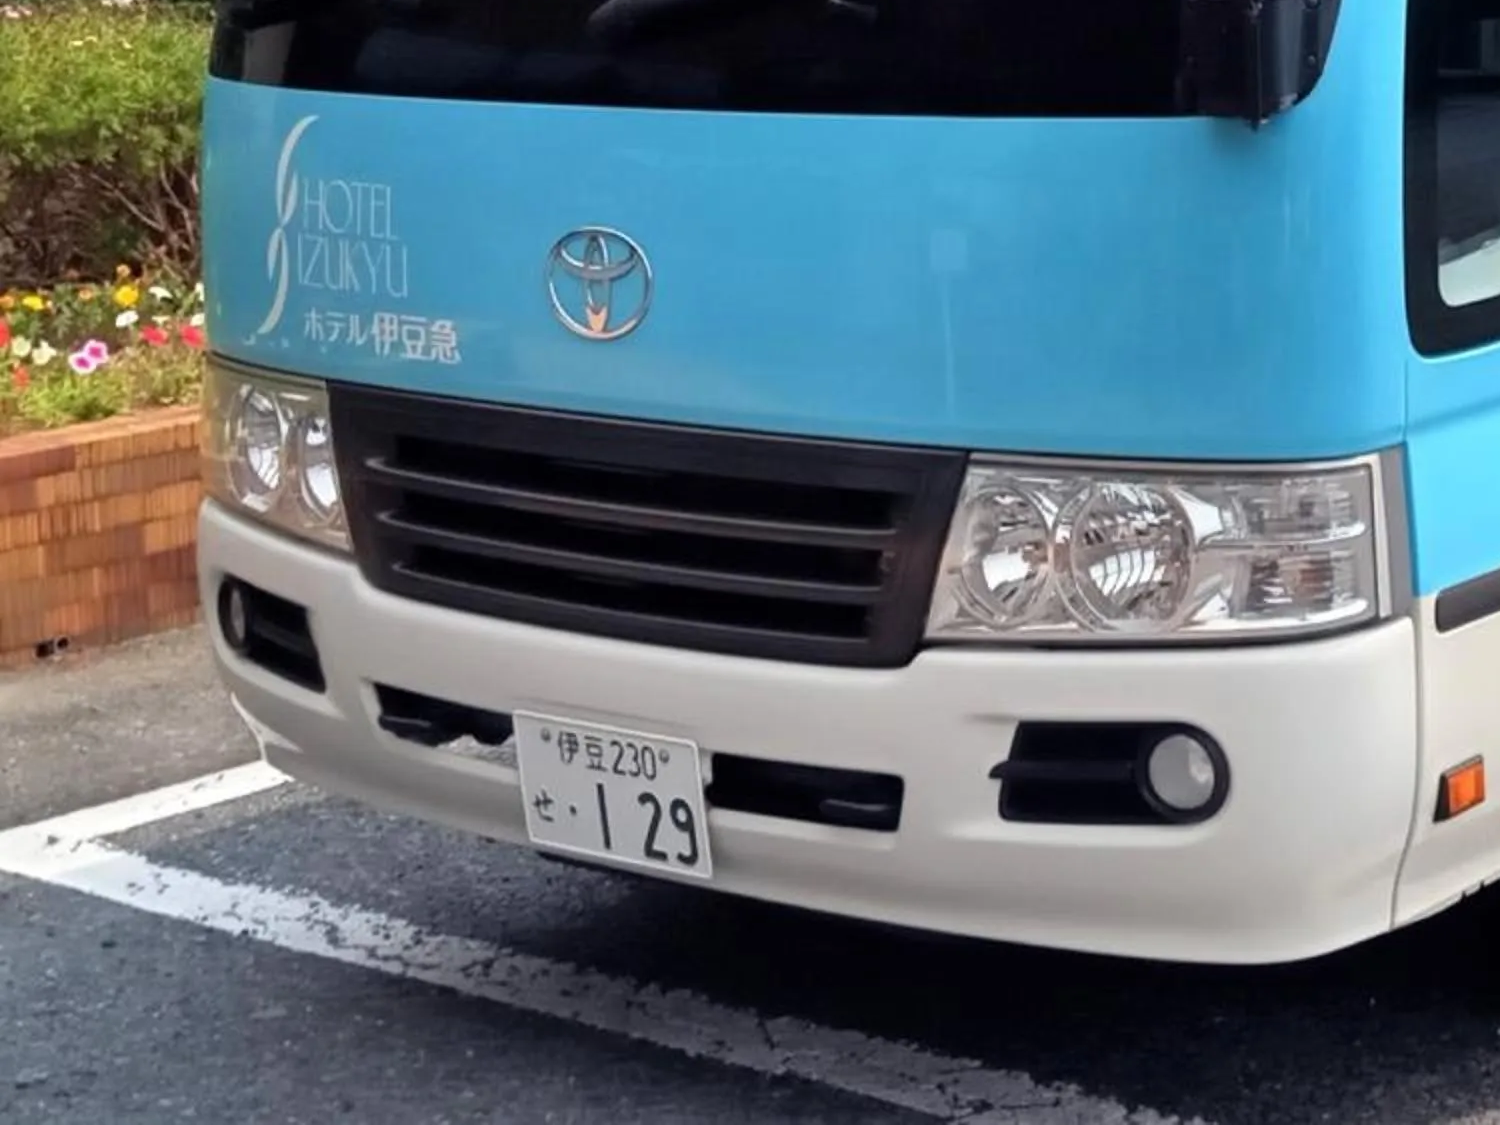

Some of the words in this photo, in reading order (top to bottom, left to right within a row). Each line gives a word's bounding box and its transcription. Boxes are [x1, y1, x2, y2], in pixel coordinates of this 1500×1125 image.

[303, 178, 399, 241] HOTEL
[297, 231, 409, 299] IZUKYU
[304, 307, 462, 365] ホテル伊豆急
